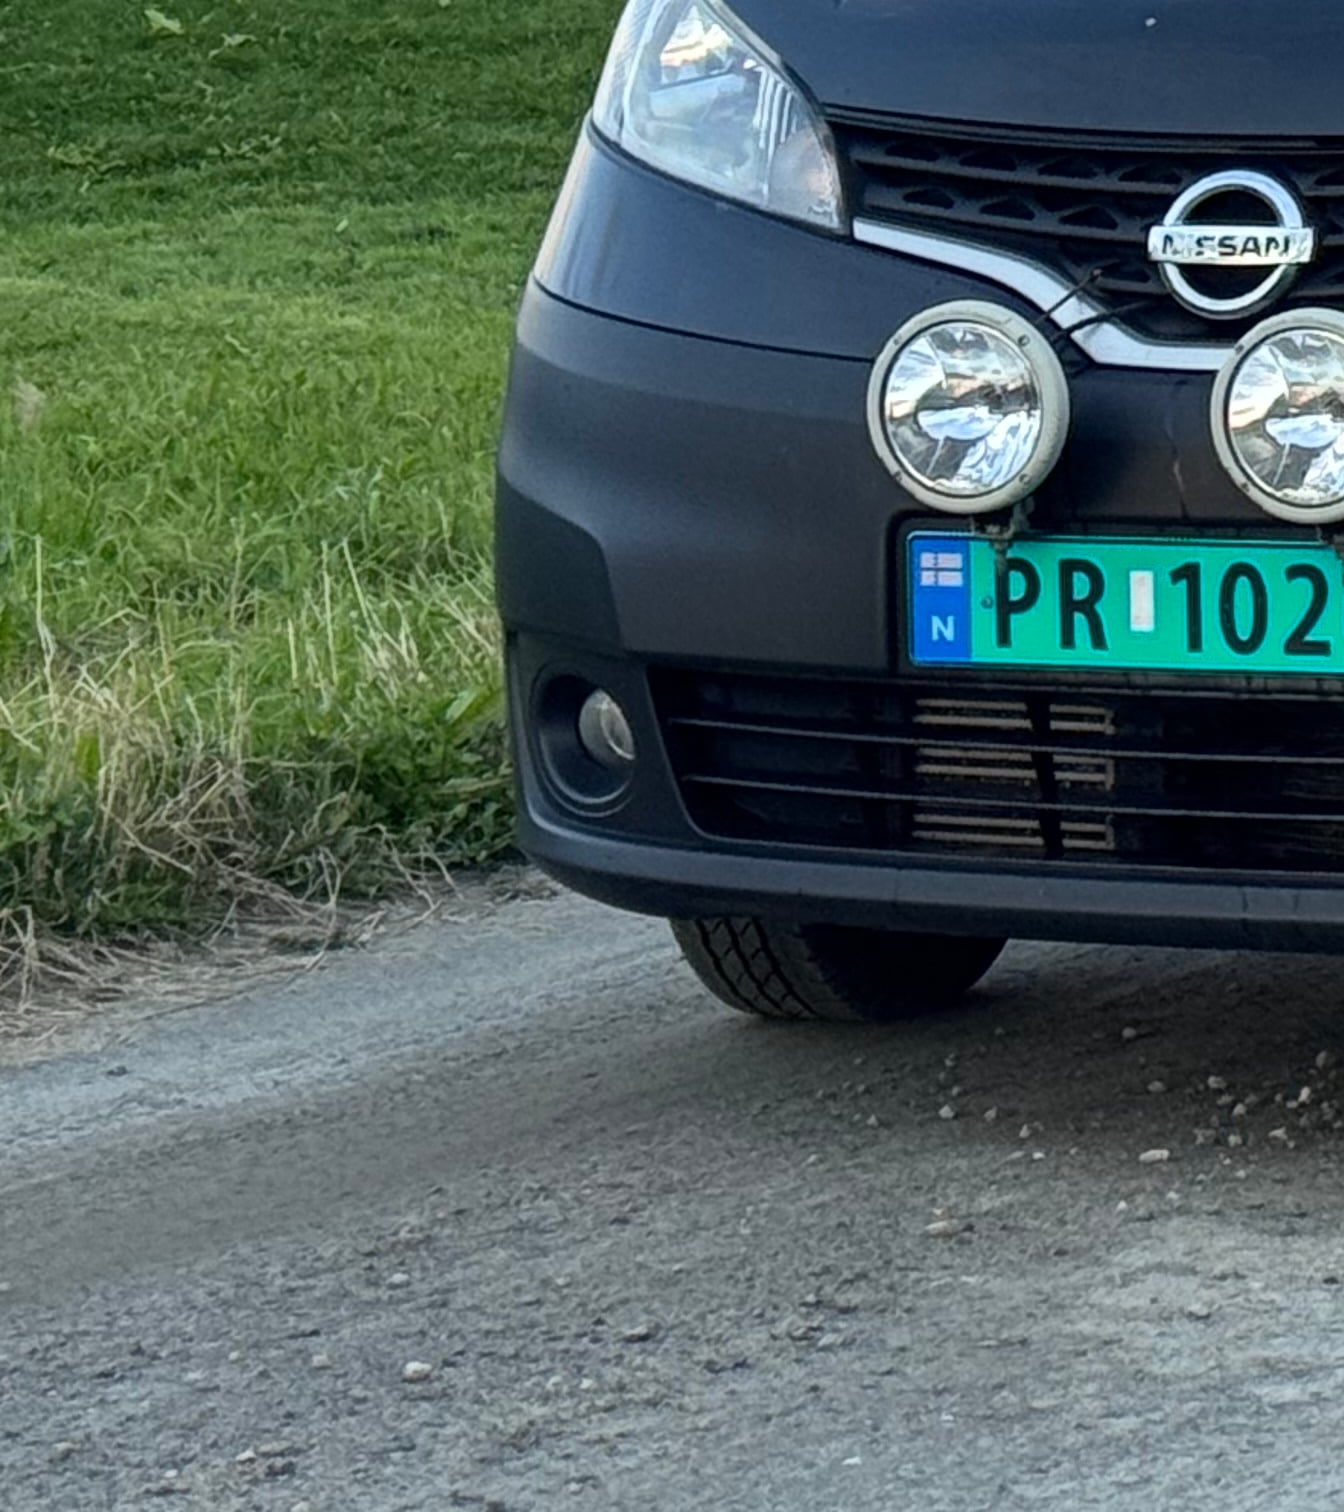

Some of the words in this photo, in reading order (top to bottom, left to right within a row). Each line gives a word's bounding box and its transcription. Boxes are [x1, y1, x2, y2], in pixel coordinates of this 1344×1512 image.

[1161, 233, 1291, 257] NSSAN
[994, 557, 1109, 651] PR
[930, 614, 956, 642] N
